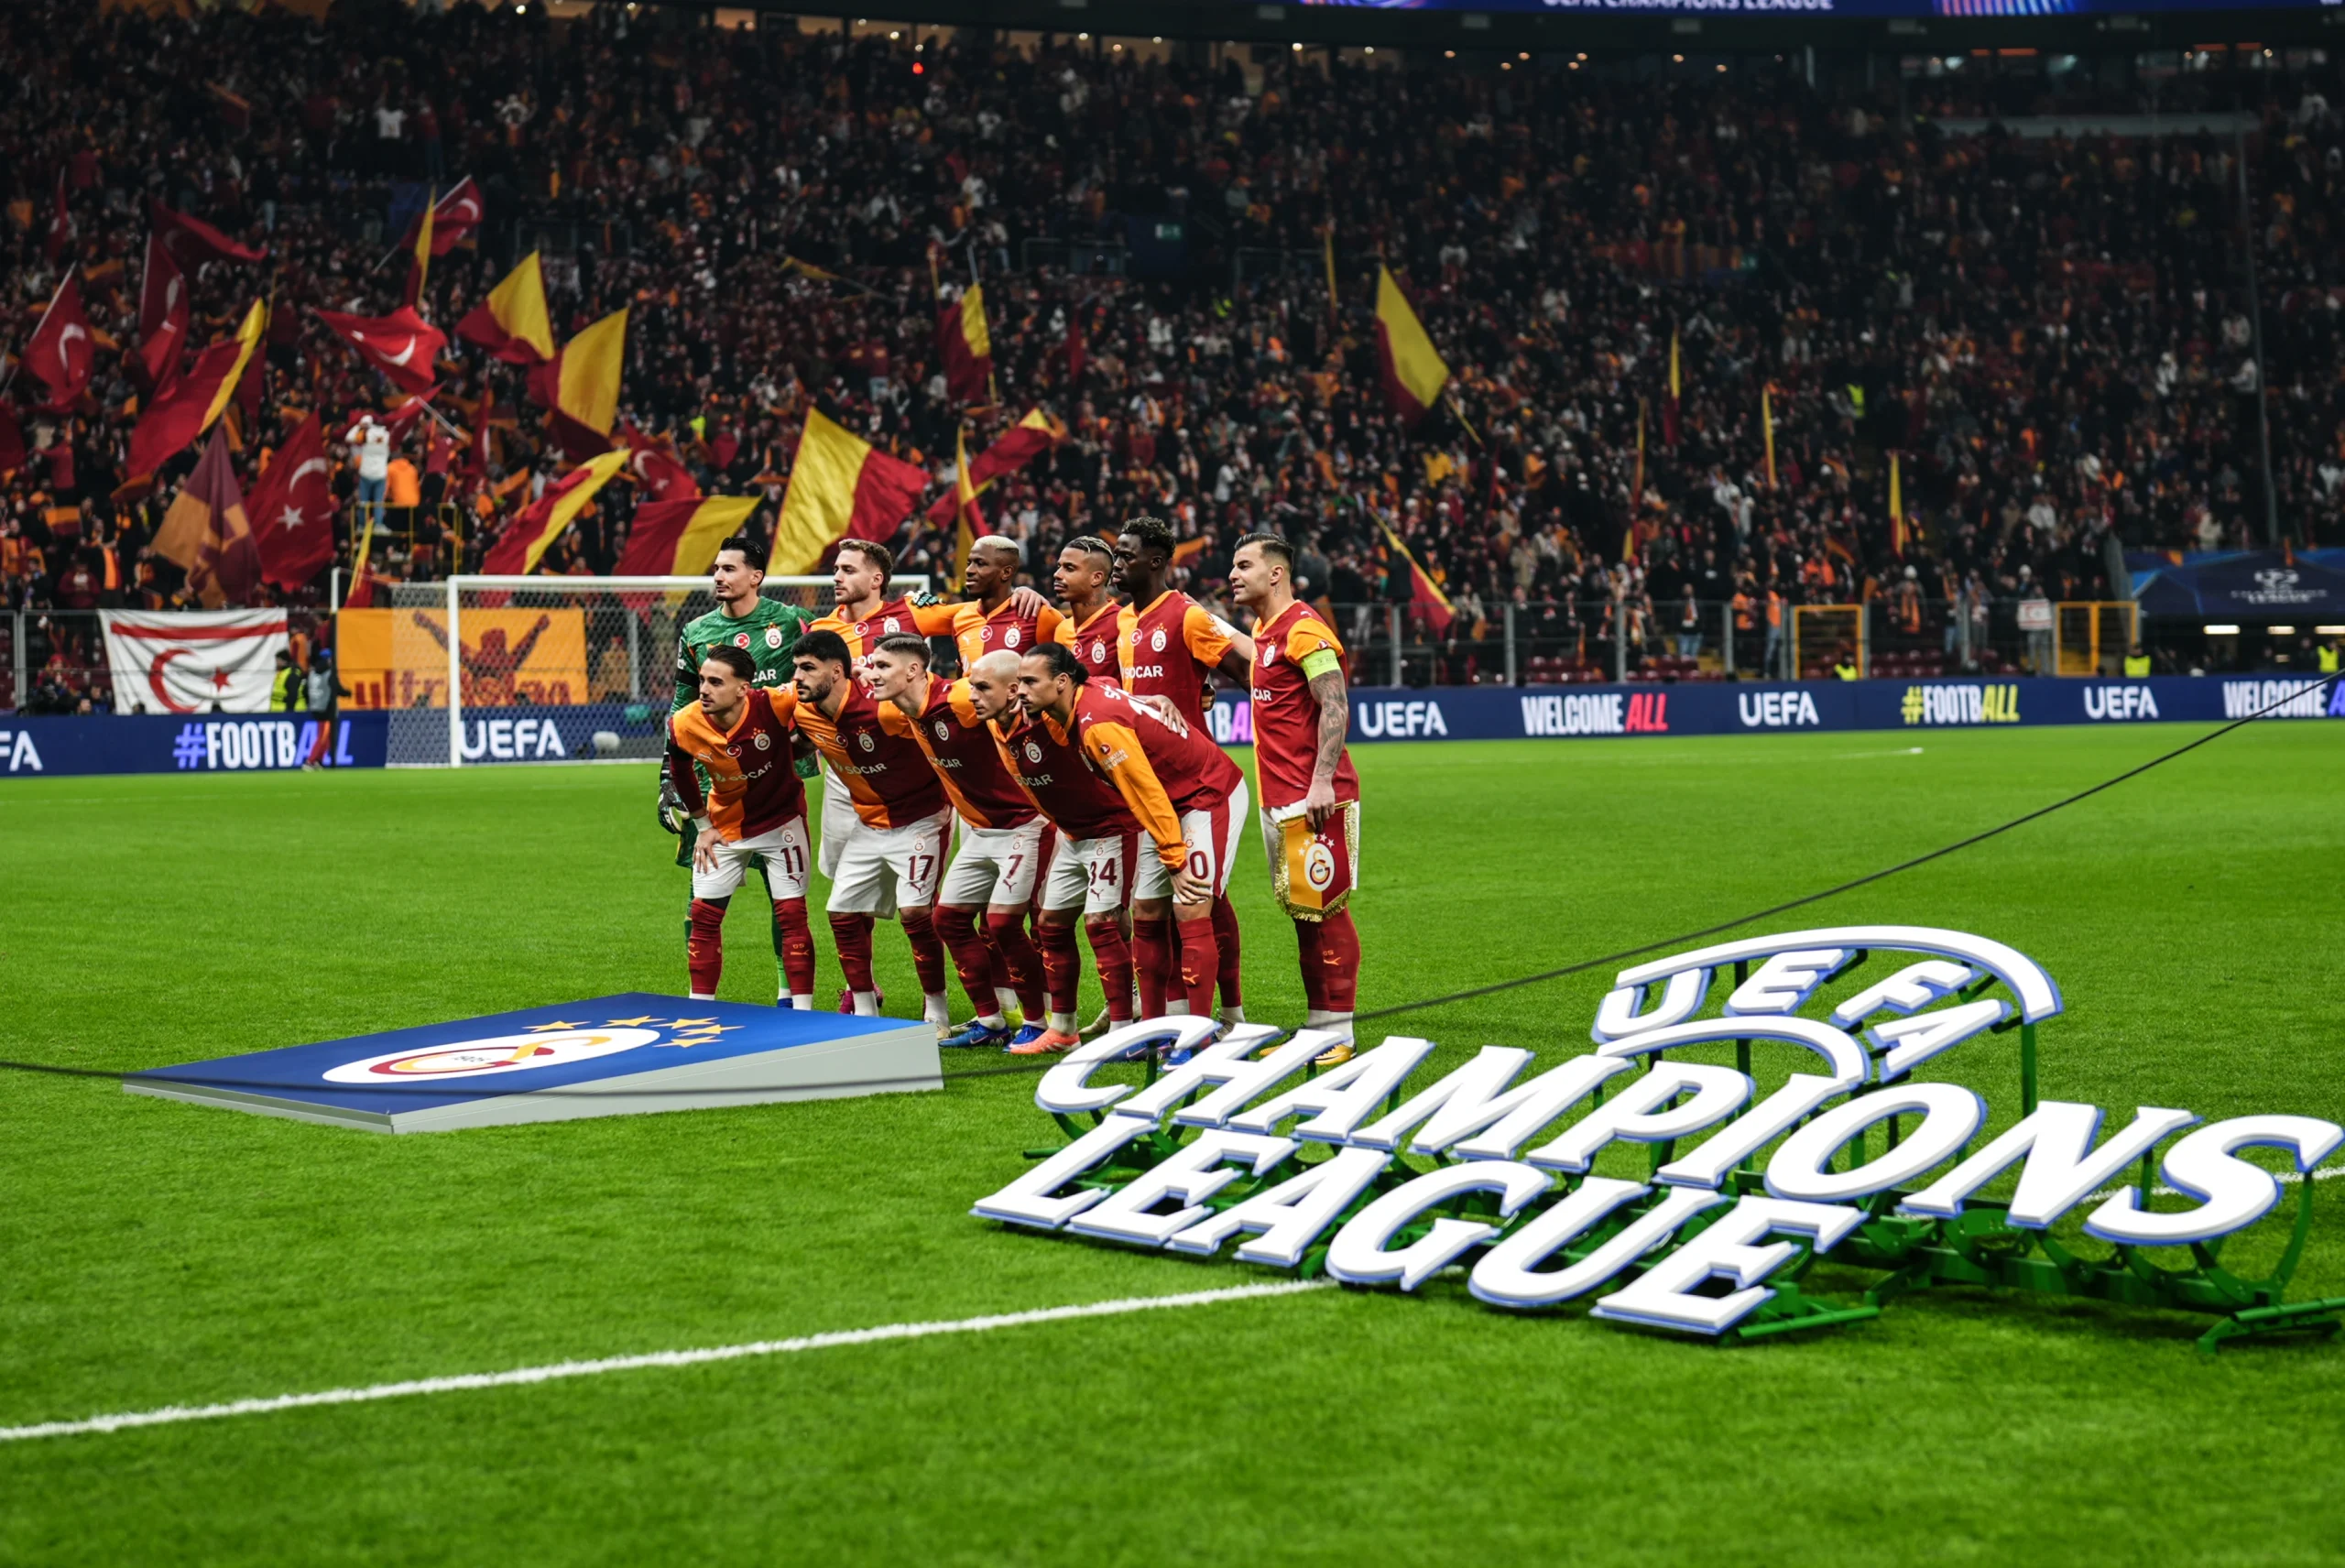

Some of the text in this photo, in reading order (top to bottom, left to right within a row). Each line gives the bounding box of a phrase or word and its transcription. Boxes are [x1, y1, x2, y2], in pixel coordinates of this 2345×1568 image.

[1520, 691, 1669, 736] WELCOME ALL
[1738, 690, 1820, 727] UEFA
[1900, 684, 2021, 724] #FOOTBALL
[2083, 685, 2160, 720] UEFA
[2222, 680, 2328, 719] WELCOME
[1357, 700, 1449, 738] UEFA
[459, 719, 566, 759] UEFA
[844, 762, 888, 776] SOCAR
[780, 844, 804, 874] 11
[908, 855, 935, 882] 17
[1006, 854, 1024, 880] 7
[1591, 947, 2012, 1083] UEFA
[1034, 1014, 2345, 1247] CHAMPIONS
[968, 1114, 1869, 1335] LEAGUE
